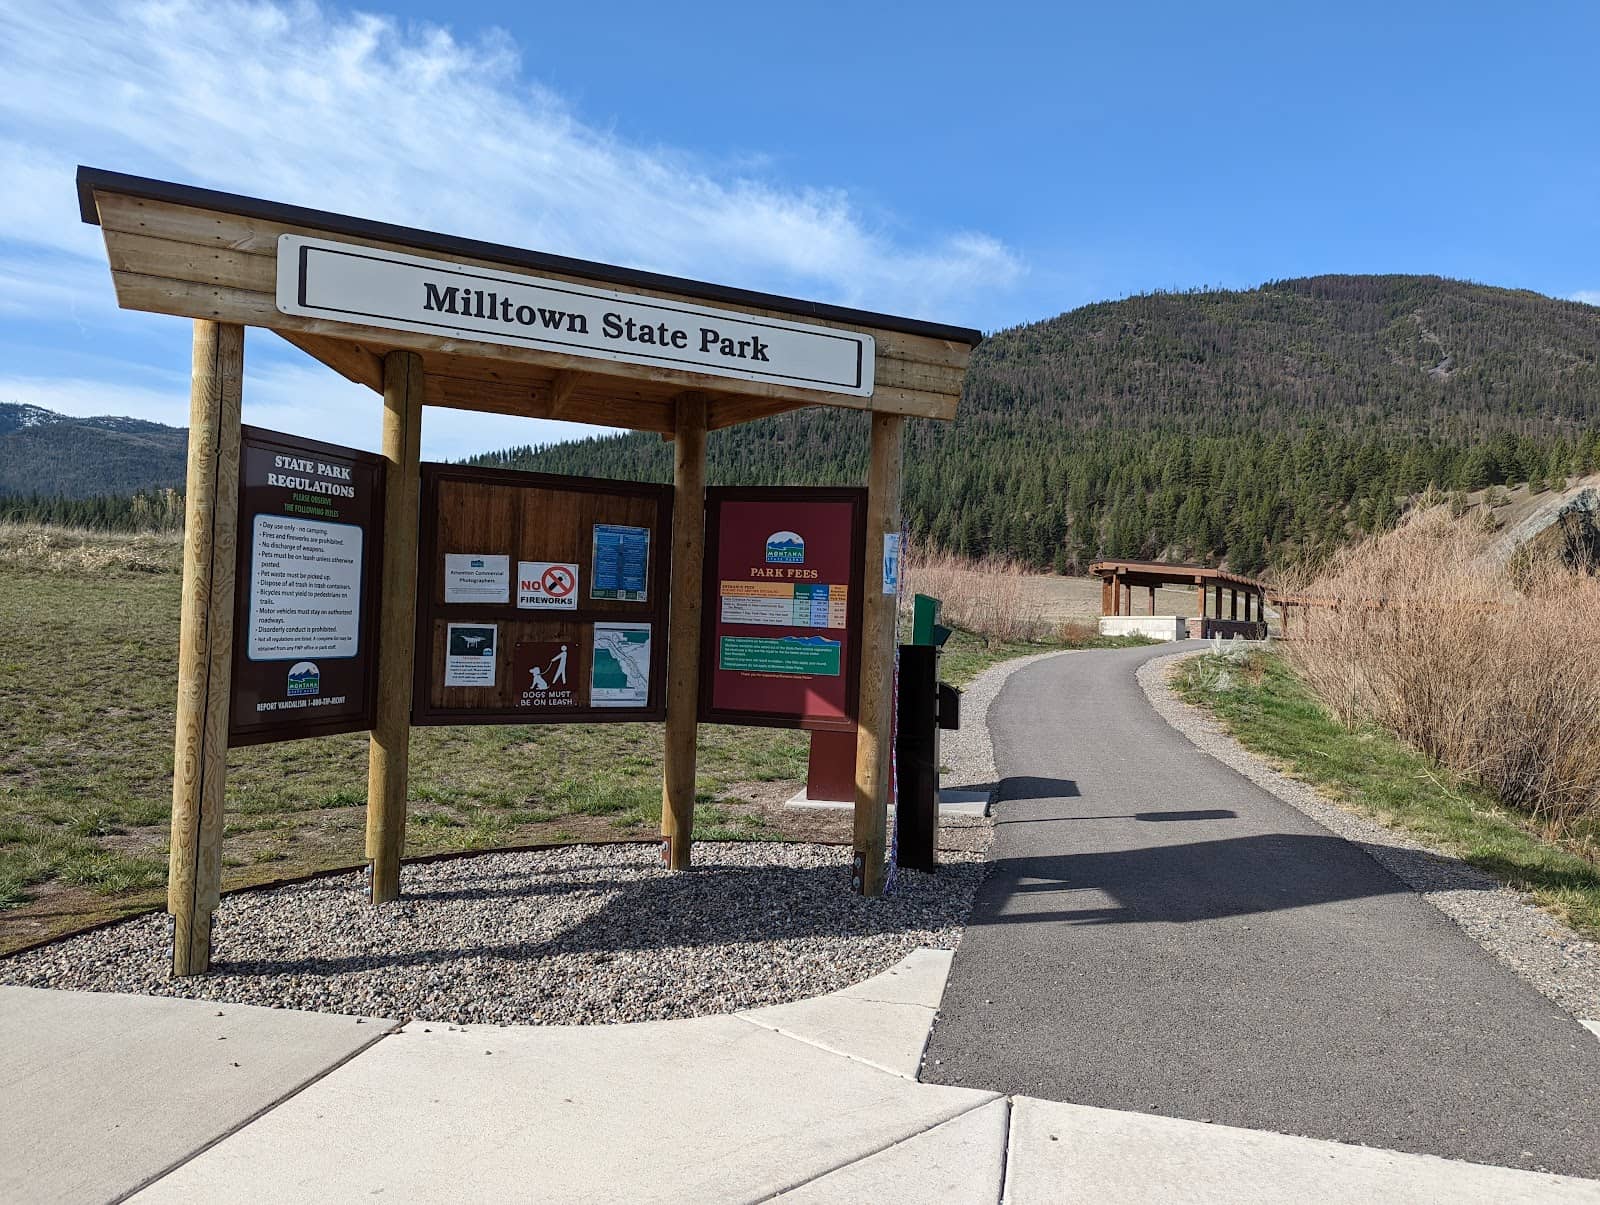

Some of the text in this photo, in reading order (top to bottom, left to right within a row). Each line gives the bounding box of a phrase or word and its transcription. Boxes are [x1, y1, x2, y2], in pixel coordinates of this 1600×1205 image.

[423, 282, 770, 363] Milltown State Park
[274, 456, 351, 480] STATE PARK
[267, 473, 354, 498] REGULATIONS
[292, 492, 332, 506] PLEASE OBSERVE
[284, 503, 339, 518] THE FOLLOWING RULES
[262, 522, 273, 530] Day
[284, 524, 295, 533] only
[286, 534, 309, 542] fireworks
[270, 542, 296, 551] discharge
[750, 567, 818, 579] PARK FEES
[260, 579, 281, 588] Dispose
[521, 580, 541, 590] NO
[520, 596, 573, 605] FIREWORKS
[257, 702, 277, 712] REPORT
[278, 700, 307, 709] VANDALISM
